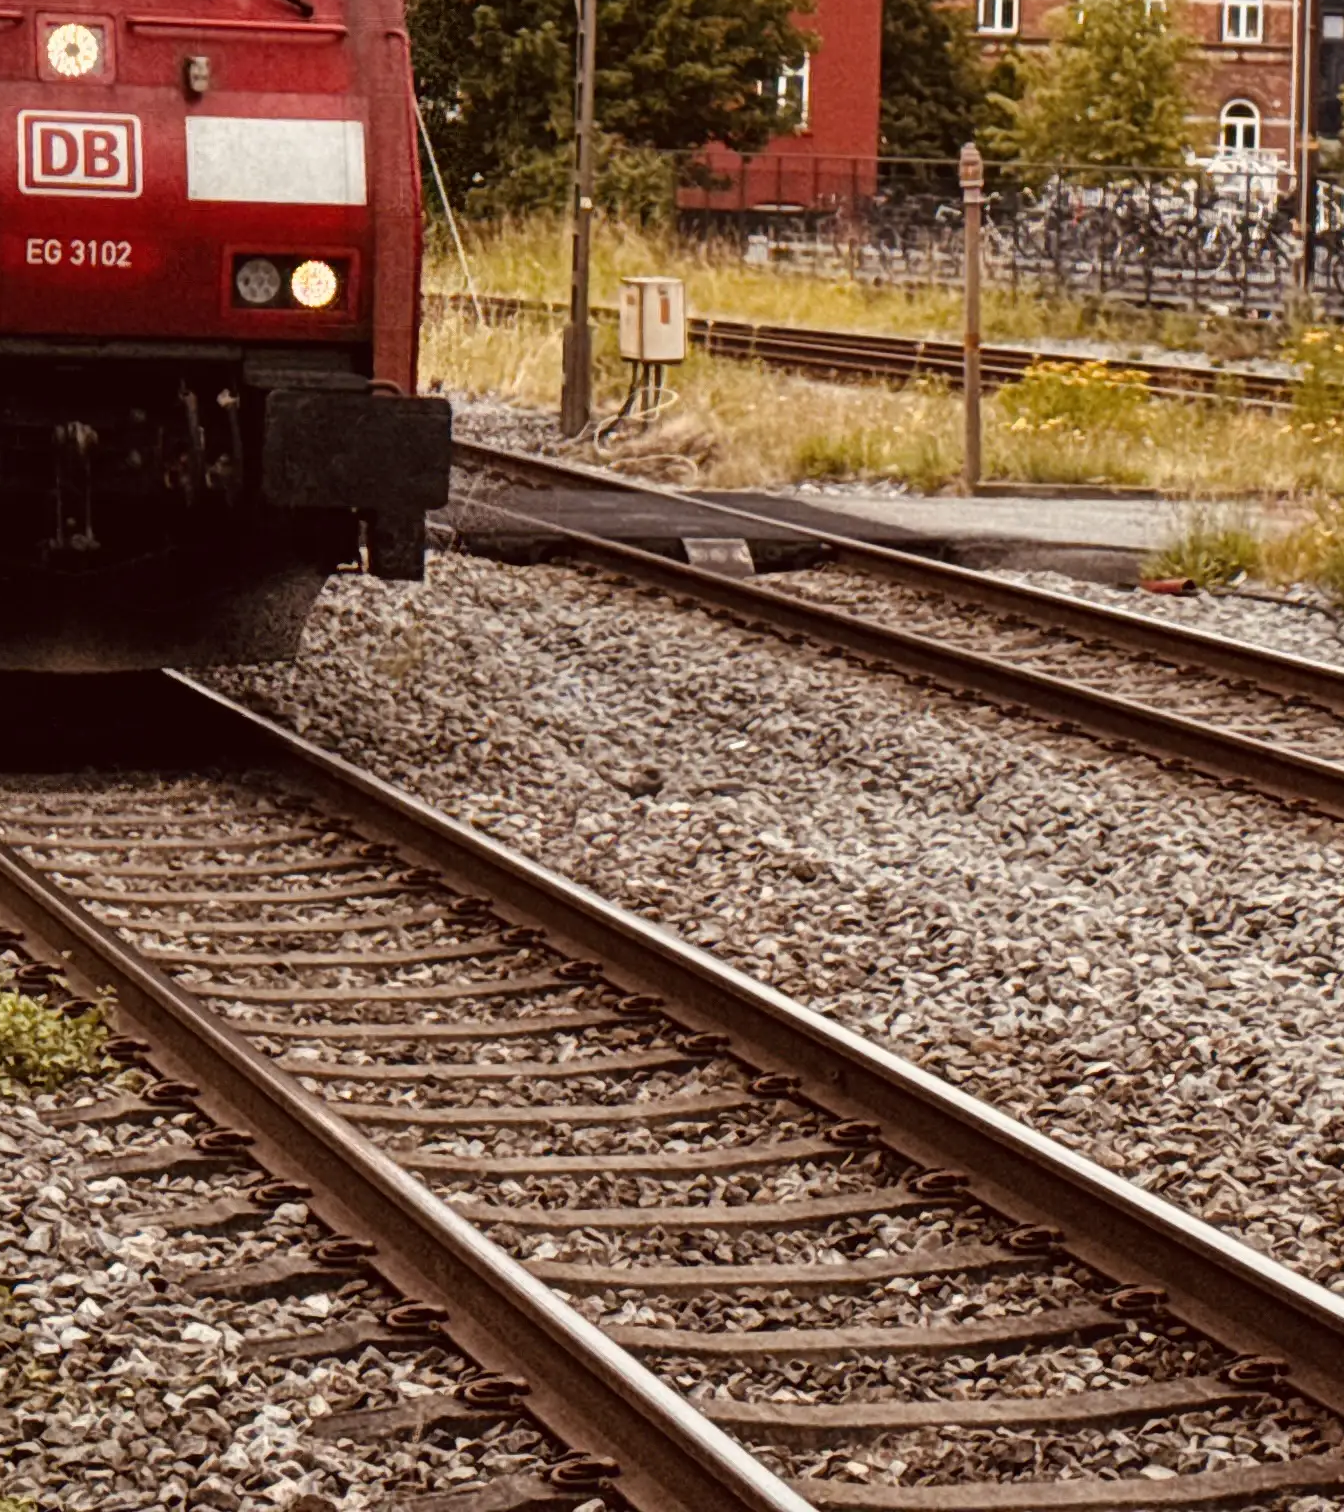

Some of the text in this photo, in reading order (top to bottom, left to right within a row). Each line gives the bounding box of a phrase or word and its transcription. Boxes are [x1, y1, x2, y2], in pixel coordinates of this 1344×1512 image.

[40, 128, 121, 179] DB
[26, 238, 134, 269] EG 3102
